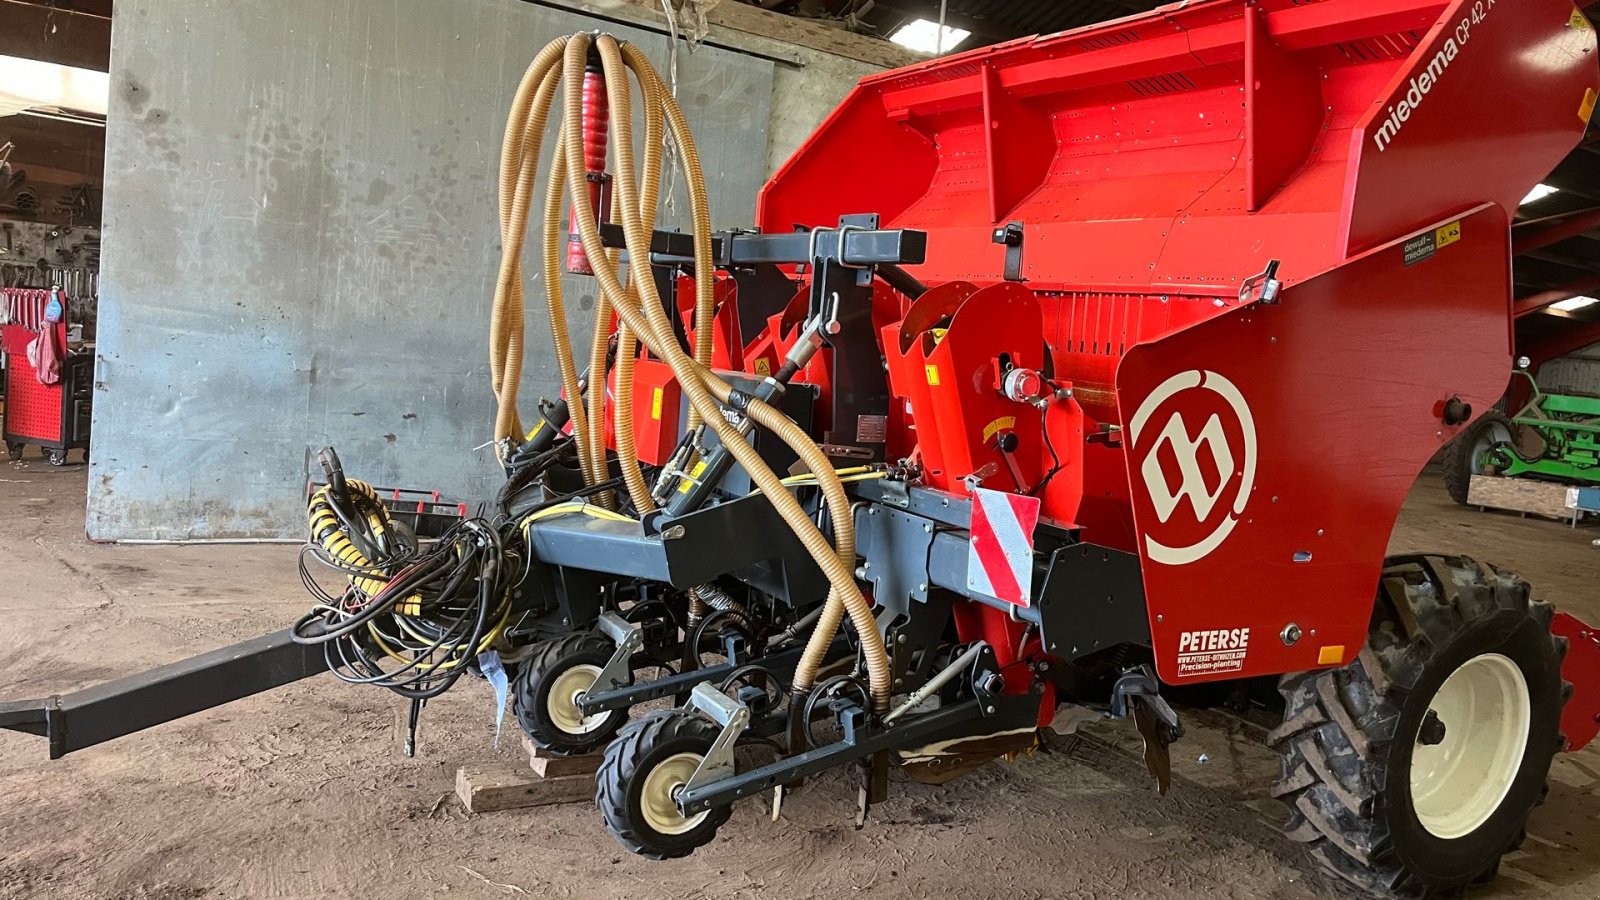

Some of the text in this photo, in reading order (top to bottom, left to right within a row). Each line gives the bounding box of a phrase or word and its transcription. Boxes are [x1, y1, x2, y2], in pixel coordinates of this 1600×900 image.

[1373, 1, 1487, 152] miedema CP 42
[1404, 244, 1435, 261] miedema
[1179, 628, 1250, 652] PETERSE
[1180, 660, 1241, 672] Precision-planting
